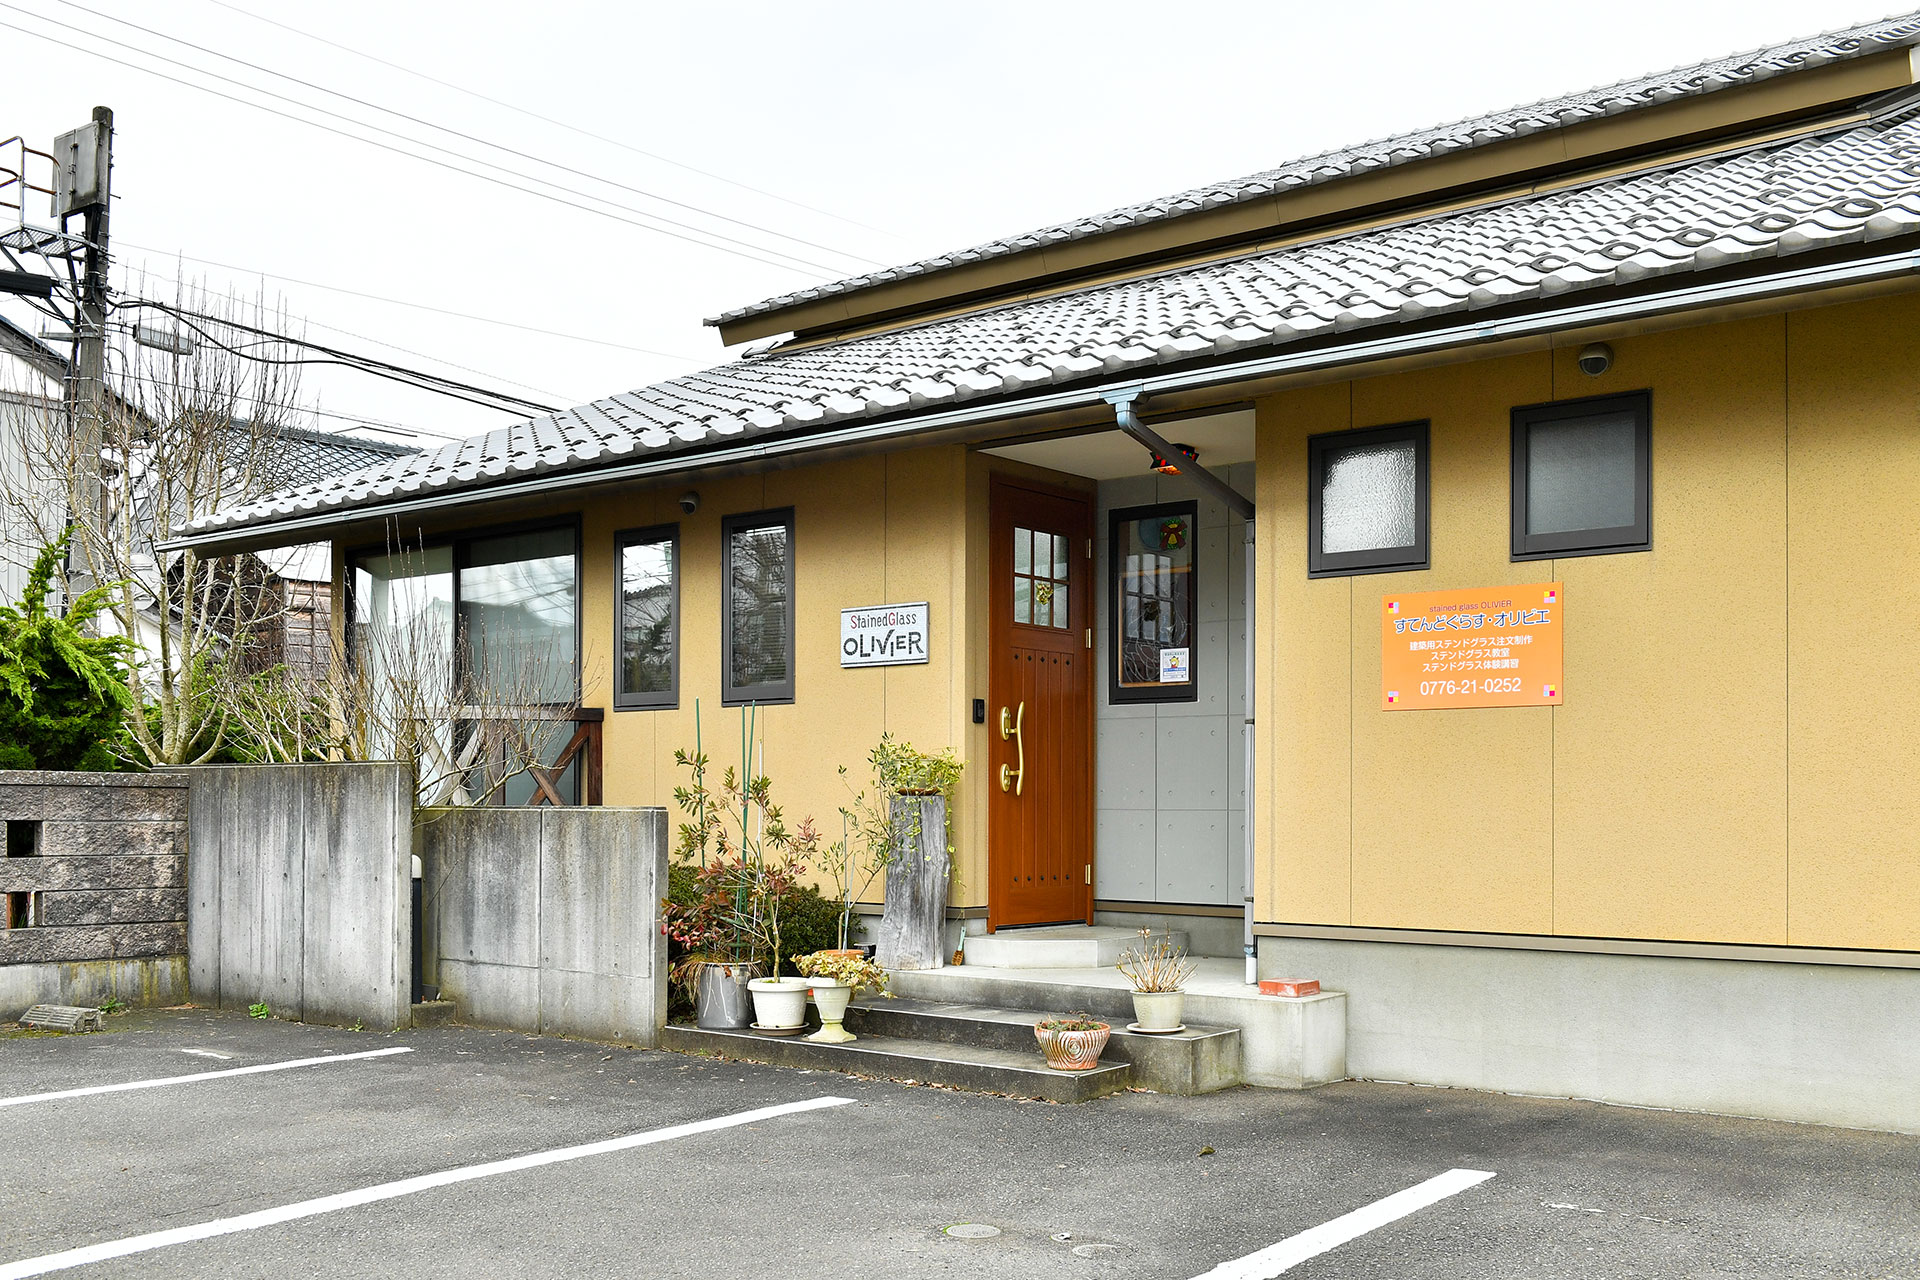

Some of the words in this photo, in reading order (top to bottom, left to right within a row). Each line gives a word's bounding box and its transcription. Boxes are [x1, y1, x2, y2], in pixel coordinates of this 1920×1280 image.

[1429, 604, 1457, 613] stained
[1459, 602, 1479, 612] glass
[1480, 600, 1512, 610] OLIVIER
[1394, 608, 1551, 634] すてんどぐらす・オリビエ
[843, 629, 924, 657] OLIVIER
[1409, 635, 1533, 651] 建築用ステンドグラス注文制作
[1431, 647, 1510, 661] ステンドグラス教室
[1422, 658, 1519, 672] ステンドグラス体験講習
[1420, 677, 1522, 696] 0776-21-0252
